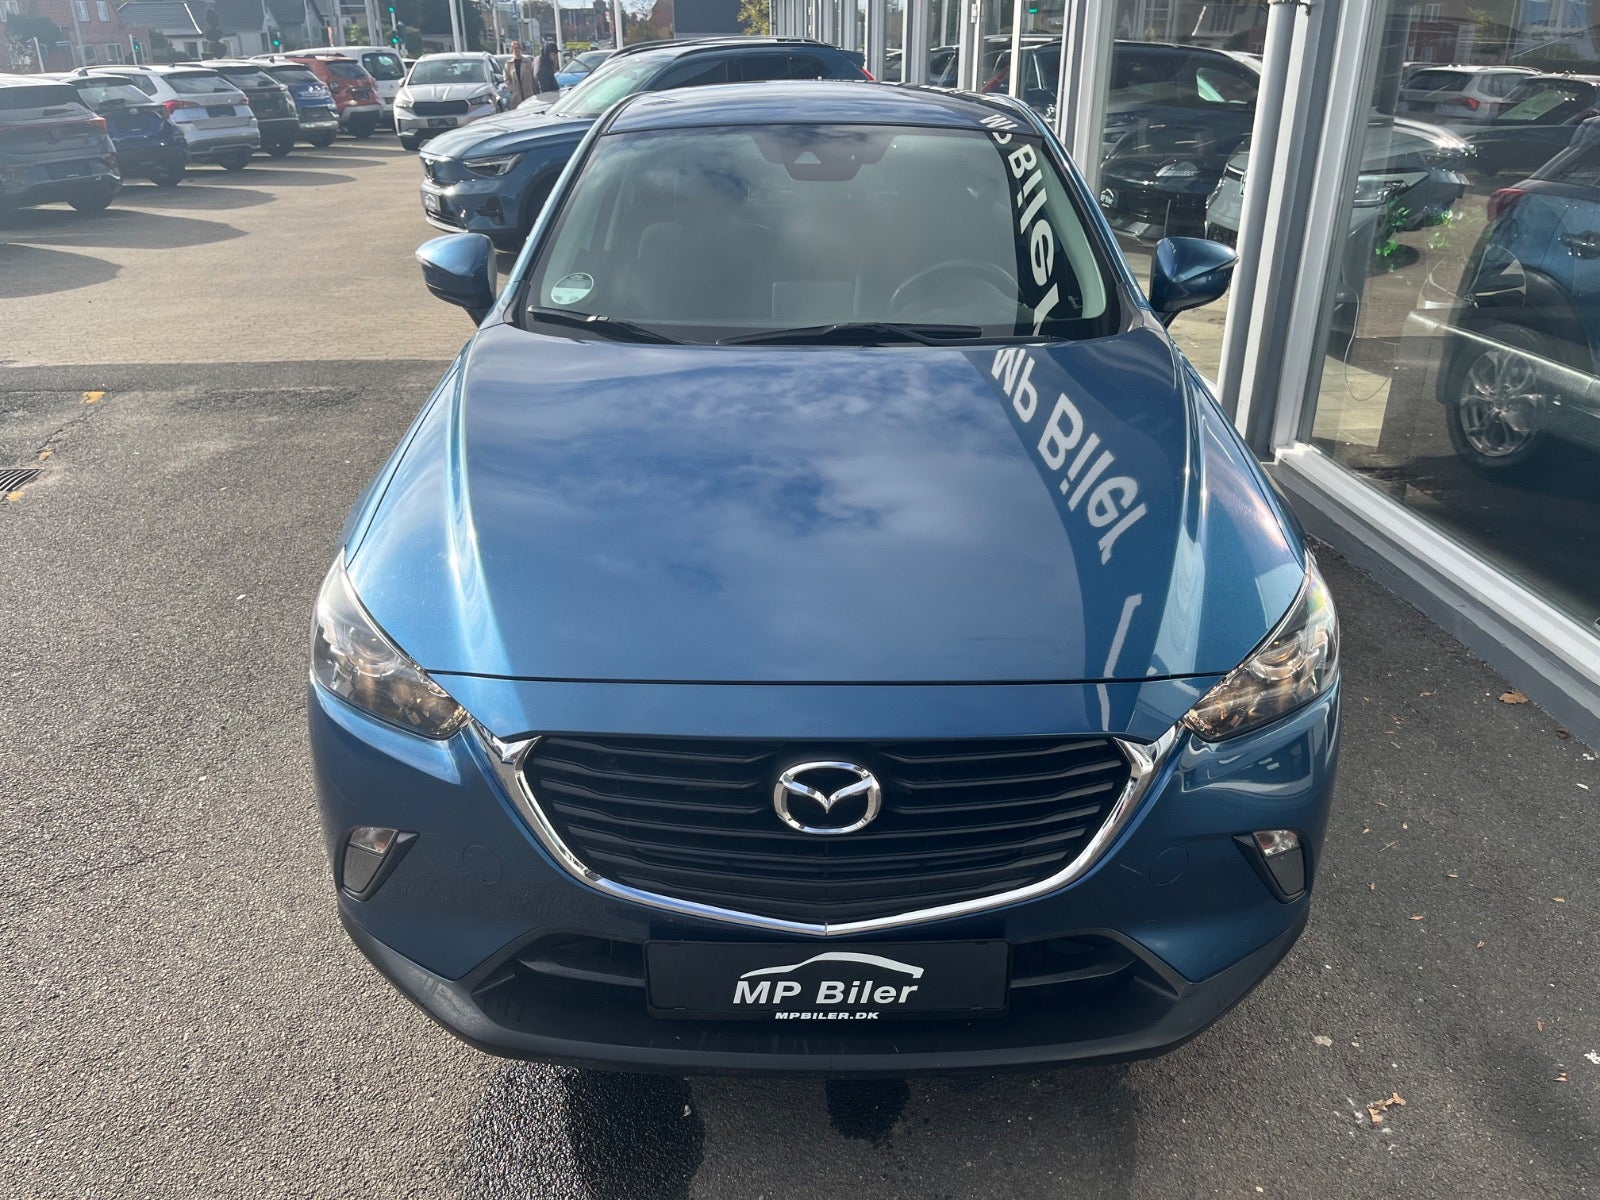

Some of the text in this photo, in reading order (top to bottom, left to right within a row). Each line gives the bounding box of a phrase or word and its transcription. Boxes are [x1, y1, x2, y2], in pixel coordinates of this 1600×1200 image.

[733, 980, 919, 1004] MP Biler
[775, 1011, 880, 1020] MPBILER.DK
